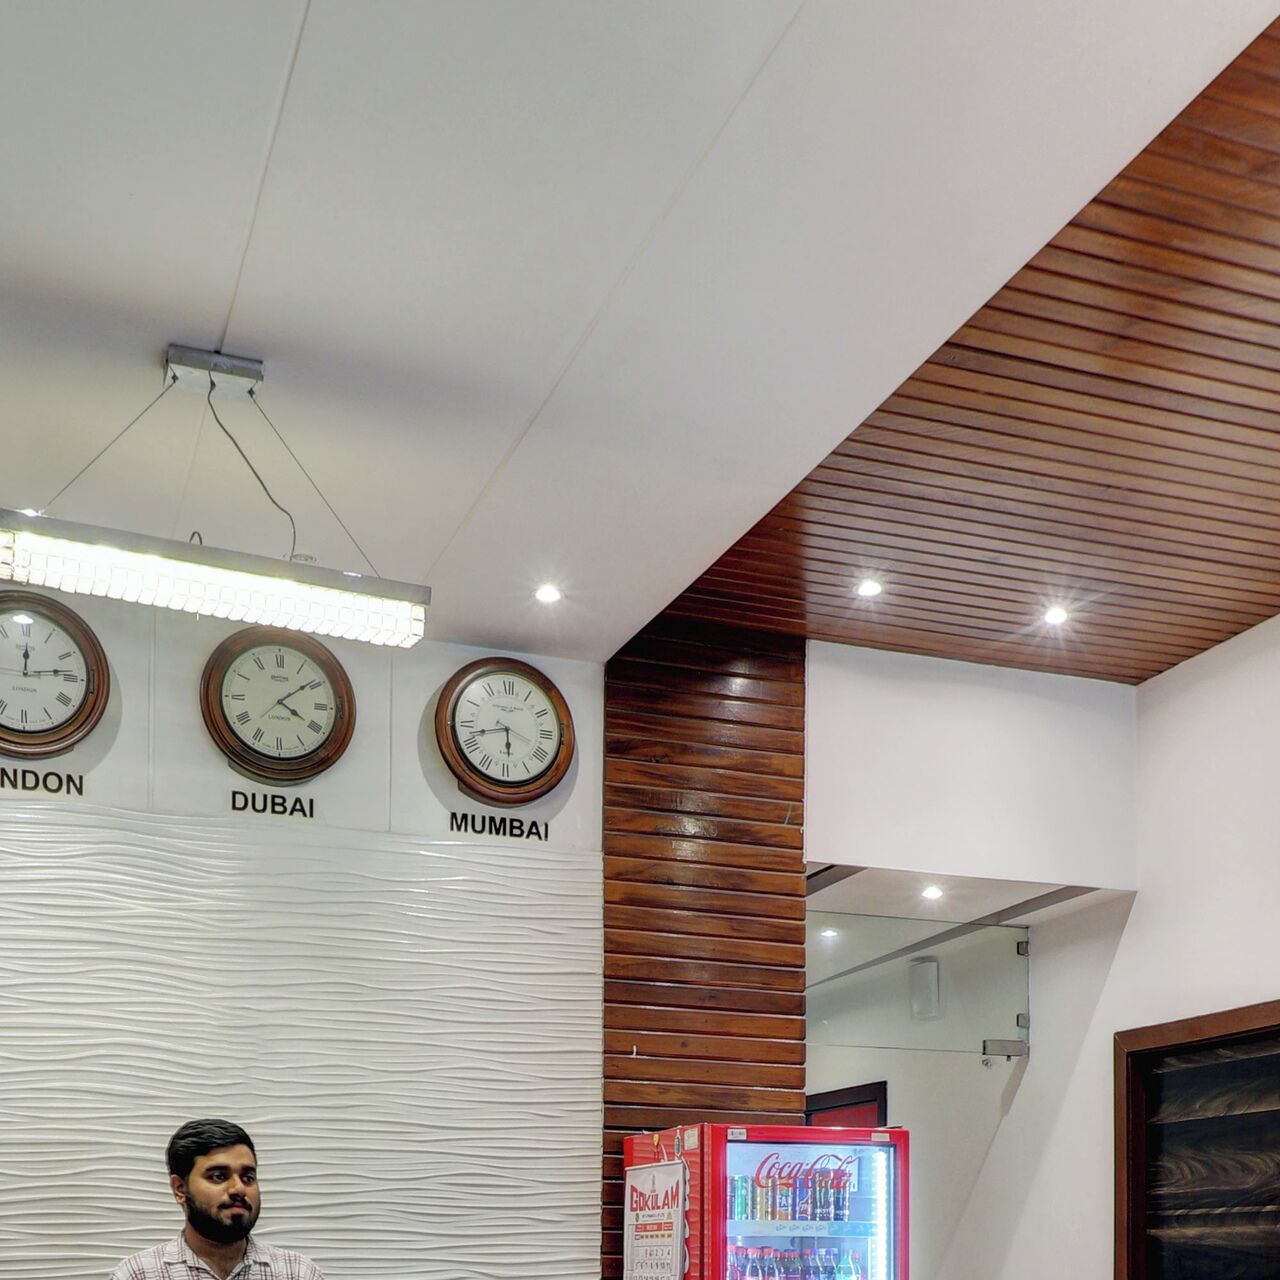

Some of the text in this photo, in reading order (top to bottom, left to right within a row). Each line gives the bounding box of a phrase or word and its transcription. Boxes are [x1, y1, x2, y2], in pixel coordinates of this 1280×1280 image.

[231, 790, 314, 818] DUBAI
[450, 812, 549, 841] MUMBAI
[630, 1179, 680, 1212] GOKULAM
